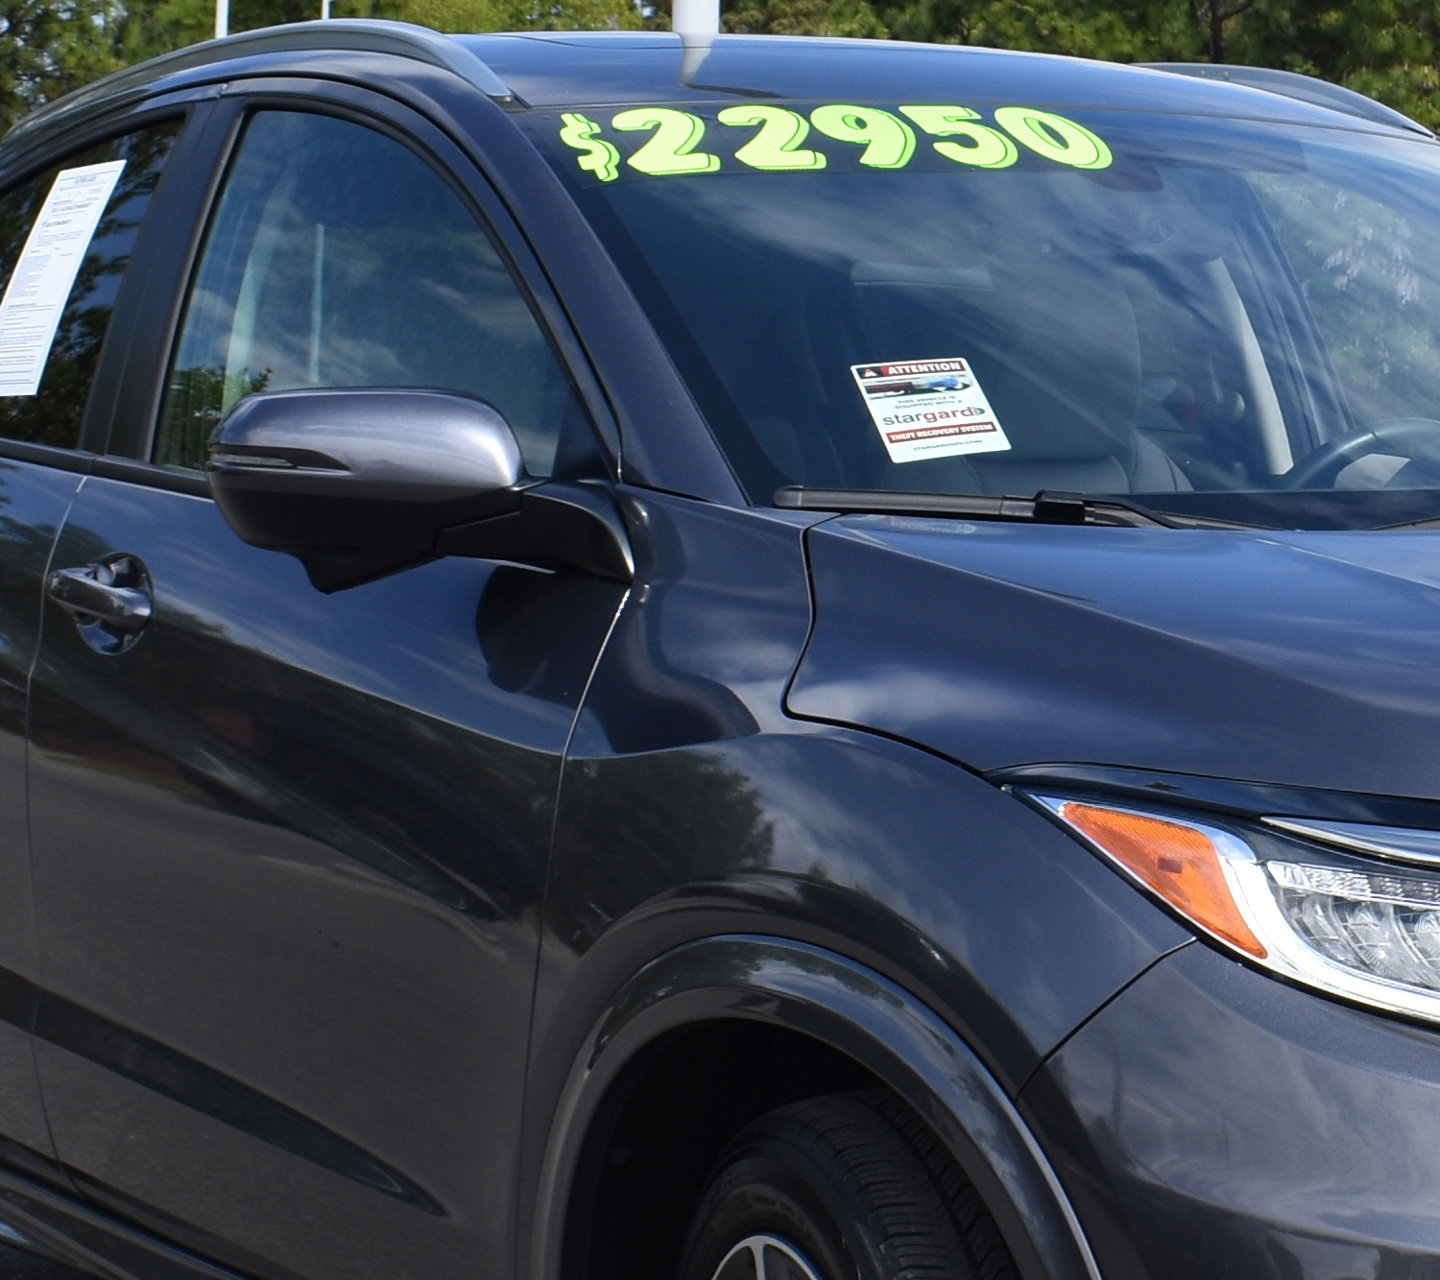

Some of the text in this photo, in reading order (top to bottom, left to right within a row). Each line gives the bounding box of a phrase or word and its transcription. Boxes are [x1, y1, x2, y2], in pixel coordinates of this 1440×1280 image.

[560, 104, 1113, 182] $22950
[887, 362, 962, 376] ATTENTION
[882, 406, 975, 426] stargard
[916, 427, 960, 438] RECOVERY
